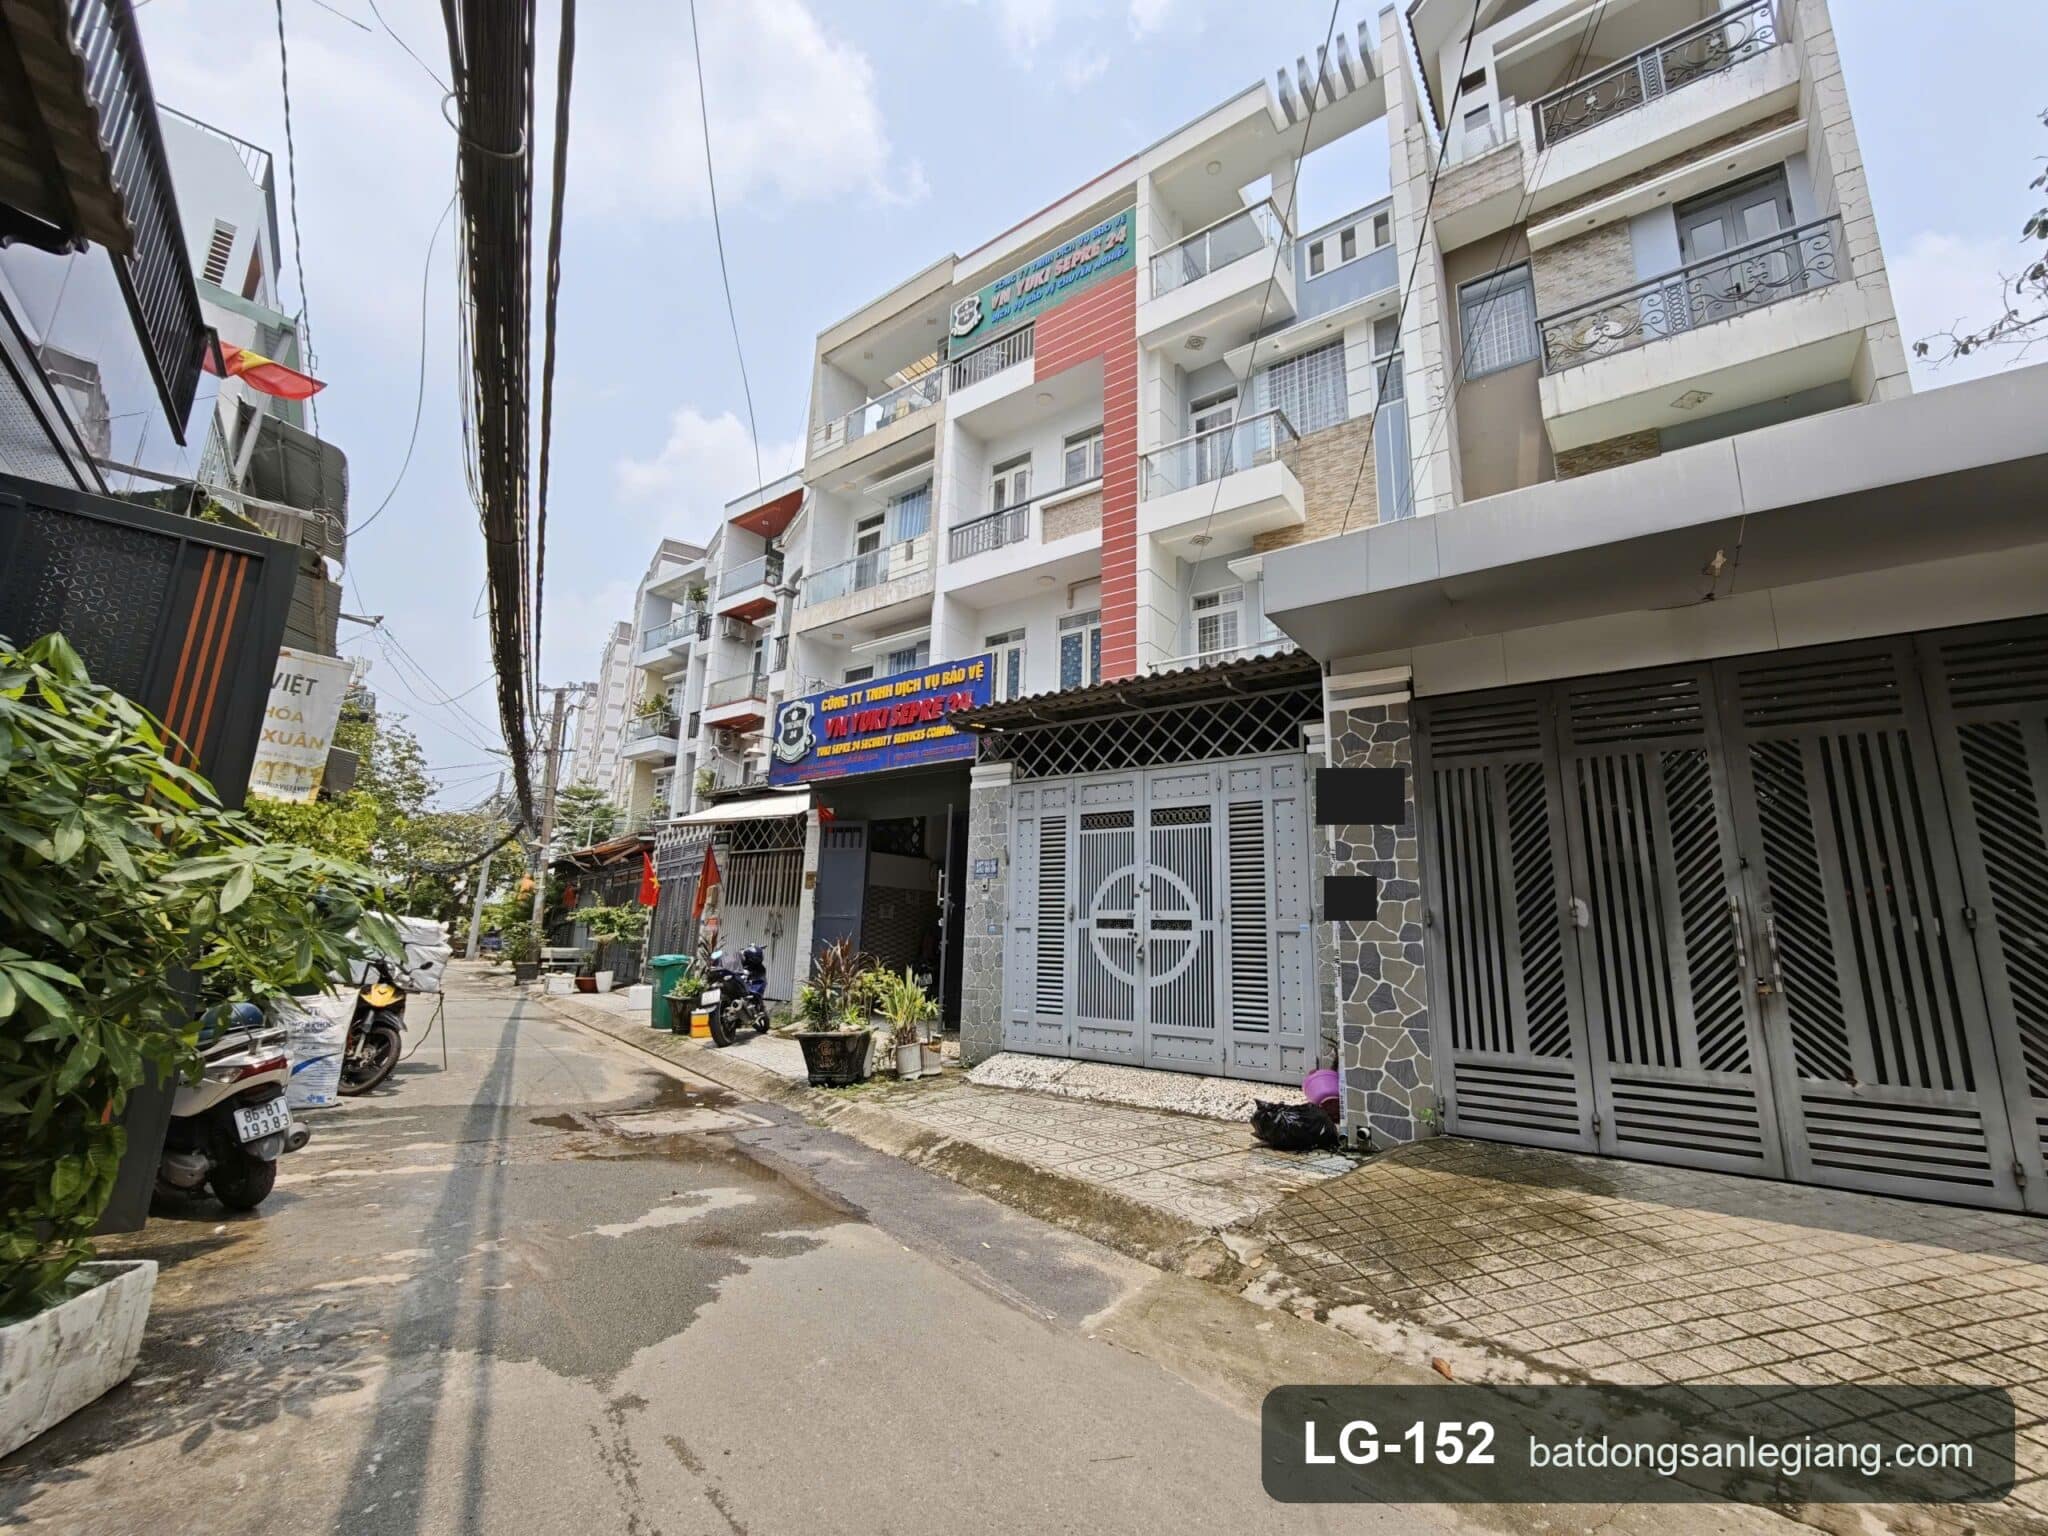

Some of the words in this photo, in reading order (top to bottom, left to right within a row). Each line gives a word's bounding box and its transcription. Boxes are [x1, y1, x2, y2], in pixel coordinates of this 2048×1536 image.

[991, 286, 1011, 311] VN
[1016, 268, 1050, 297] YUKI
[1055, 241, 1102, 278] SEPRE
[1104, 226, 1127, 253] 24
[821, 695, 849, 712] CÔNG
[850, 690, 863, 706] TY
[866, 683, 893, 702] TNHH
[895, 677, 922, 697] DỊCH
[924, 672, 940, 691] VỤ
[942, 664, 966, 686] BẢO
[968, 660, 985, 682] VỆ
[262, 728, 325, 750] XUÂN
[824, 715, 849, 739] VN
[850, 706, 889, 735] YUKI
[888, 695, 947, 729] SEPRE
[861, 733, 894, 751] SECURITY
[892, 728, 926, 746] SERVICES
